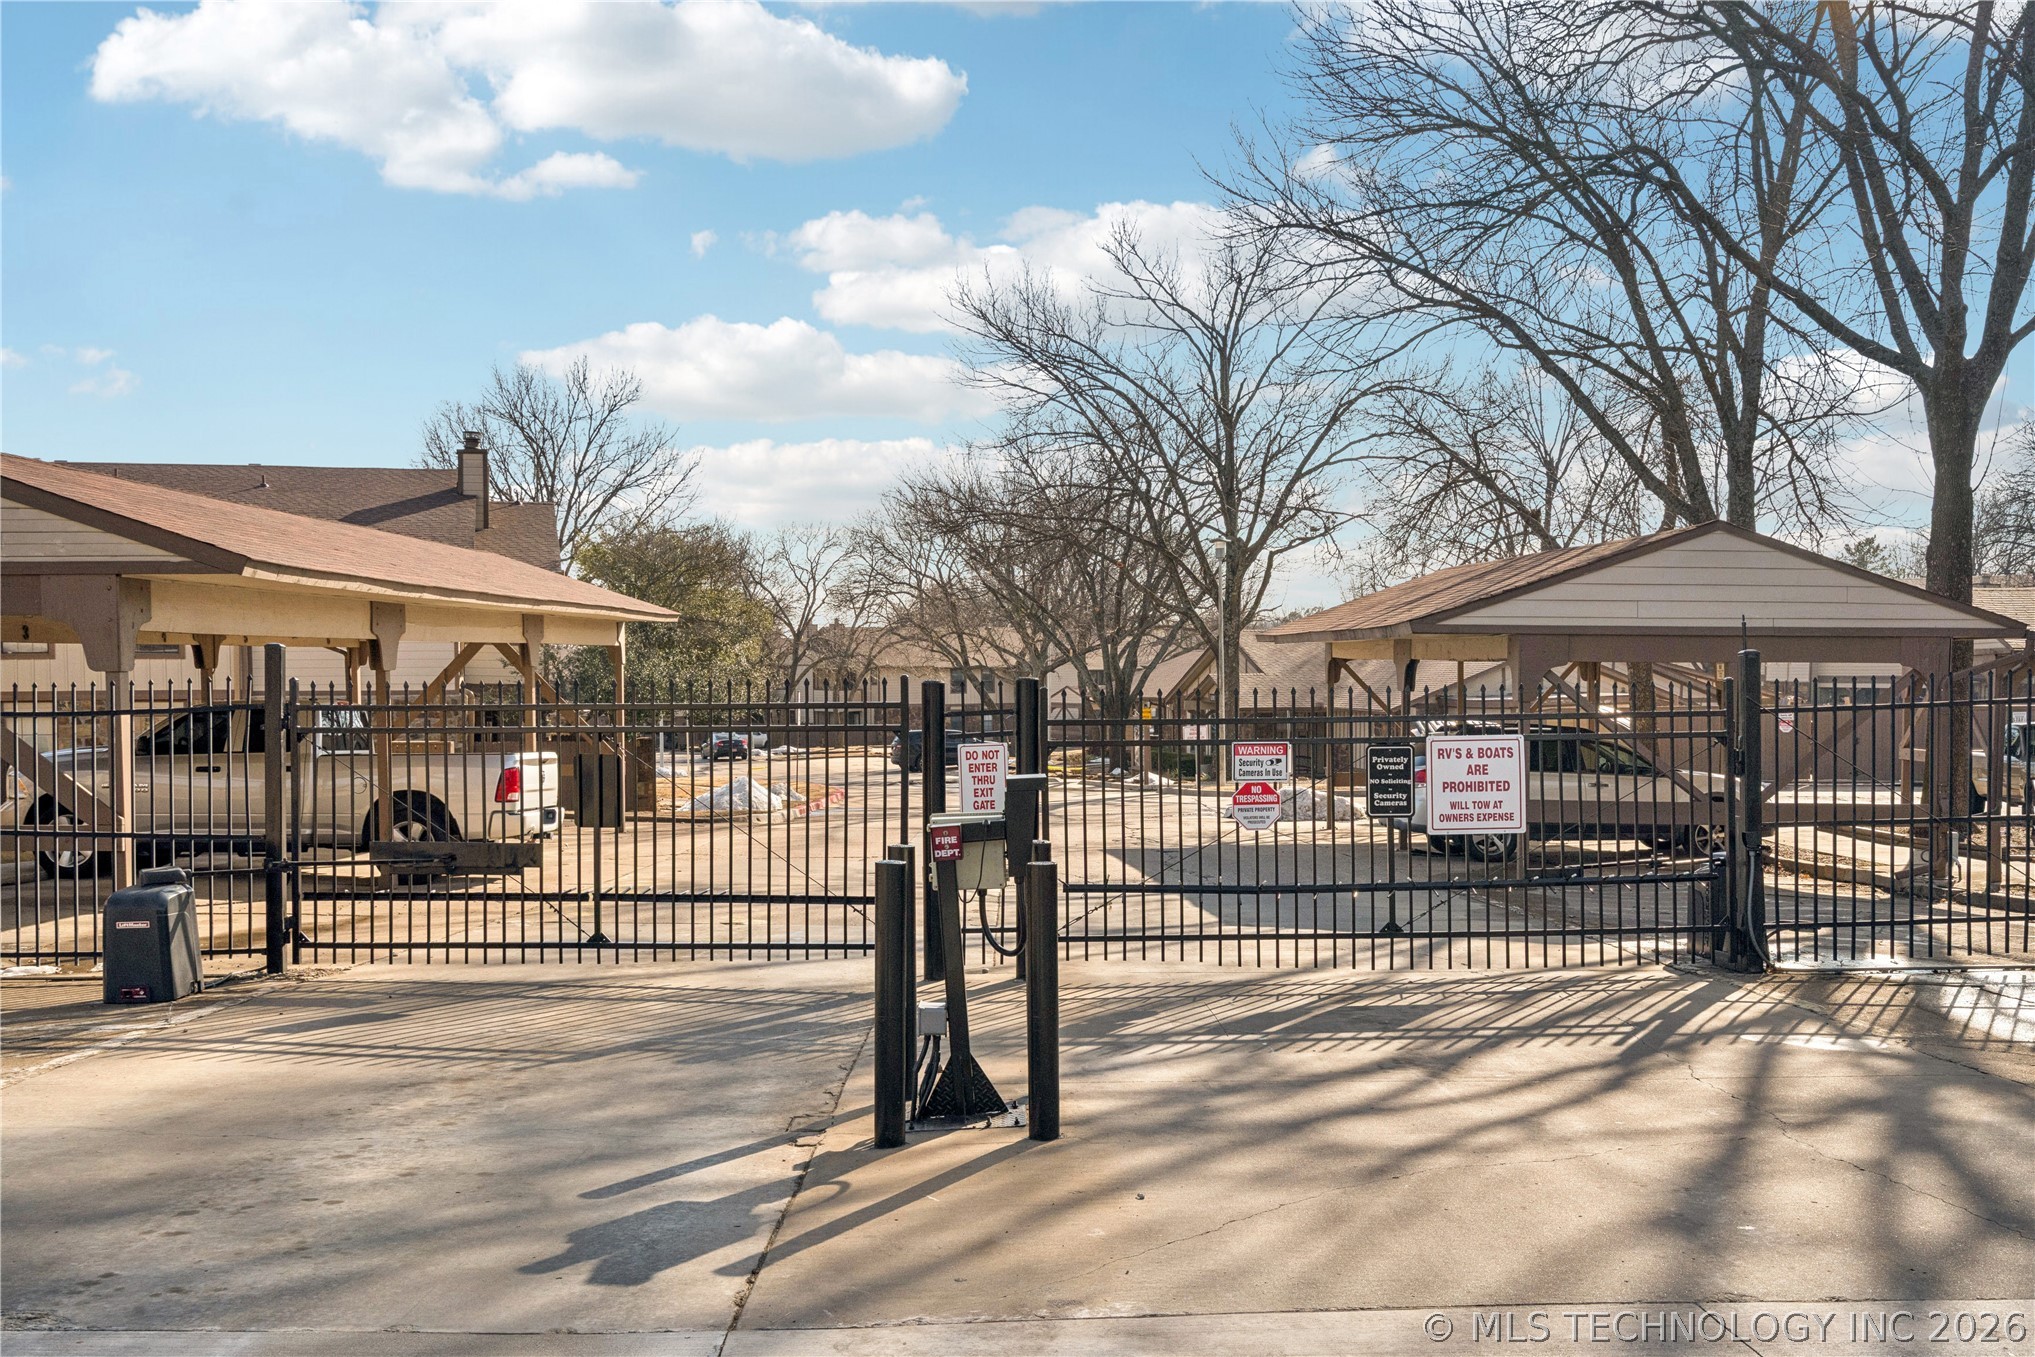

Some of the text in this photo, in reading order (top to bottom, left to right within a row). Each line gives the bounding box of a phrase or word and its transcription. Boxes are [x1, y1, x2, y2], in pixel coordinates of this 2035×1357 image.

[965, 750, 1000, 761] DO NOT
[1238, 746, 1284, 755] WARNING
[1437, 747, 1514, 760] RV'S & BOATS
[1238, 758, 1264, 768] Security
[1372, 756, 1408, 764] Privately
[968, 763, 998, 773] ENTER
[1238, 768, 1282, 777] Cameras In Use
[1466, 764, 1489, 776] ARE
[971, 775, 996, 785] THRU
[1251, 785, 1262, 794] NO
[1442, 781, 1510, 793] PROHIBITED
[973, 787, 994, 798] EXIT
[1374, 792, 1407, 800] Security
[1235, 794, 1278, 803] TRESPASSING
[973, 800, 996, 810] GATE
[1449, 800, 1503, 810] WILL TOW AT
[1438, 812, 1515, 823] OWNERS EXPENSE
[935, 836, 958, 844] FIRE
[934, 849, 961, 858] DEPT.
